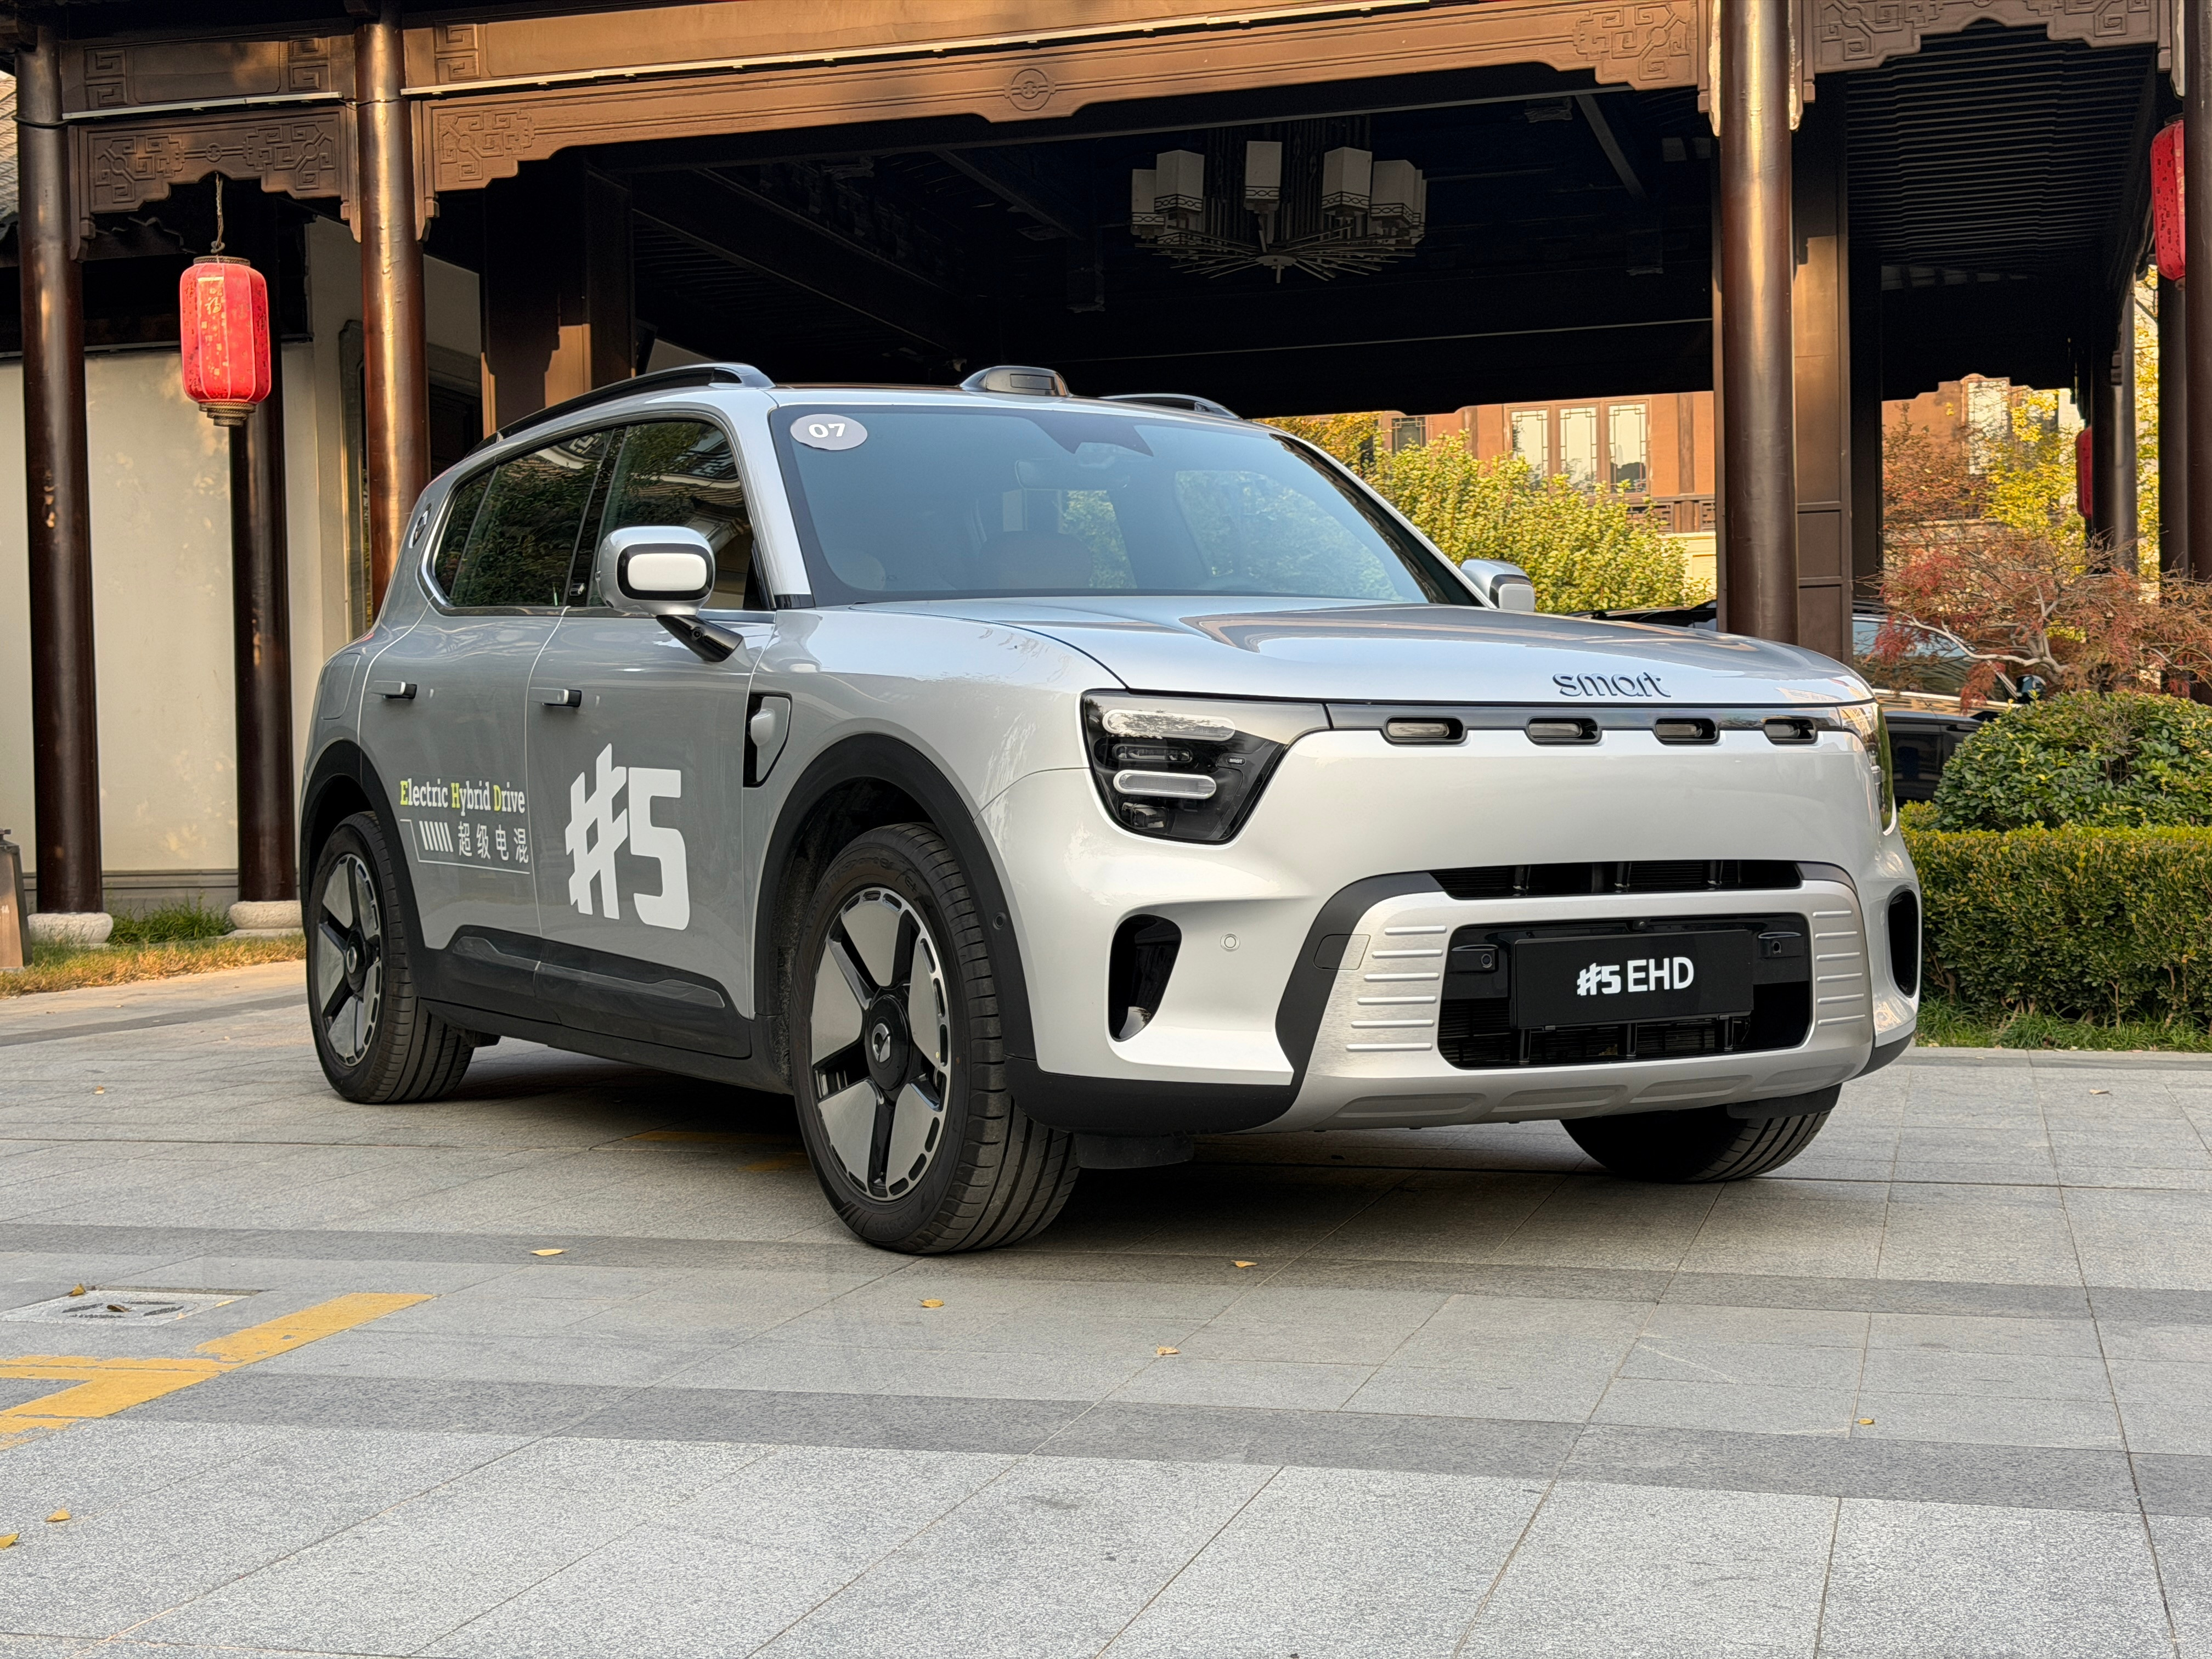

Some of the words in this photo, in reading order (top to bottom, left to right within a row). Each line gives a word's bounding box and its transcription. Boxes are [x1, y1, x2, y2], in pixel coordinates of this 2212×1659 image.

[809, 423, 845, 438] 07
[1553, 672, 1672, 698] smart
[400, 778, 448, 808] Electric
[451, 780, 491, 816] Hybrid
[493, 782, 525, 814] Drive
[458, 821, 529, 864] 超级电混
[565, 743, 690, 930] #5
[1577, 962, 1621, 996] #5
[1627, 957, 1694, 992] EHD
